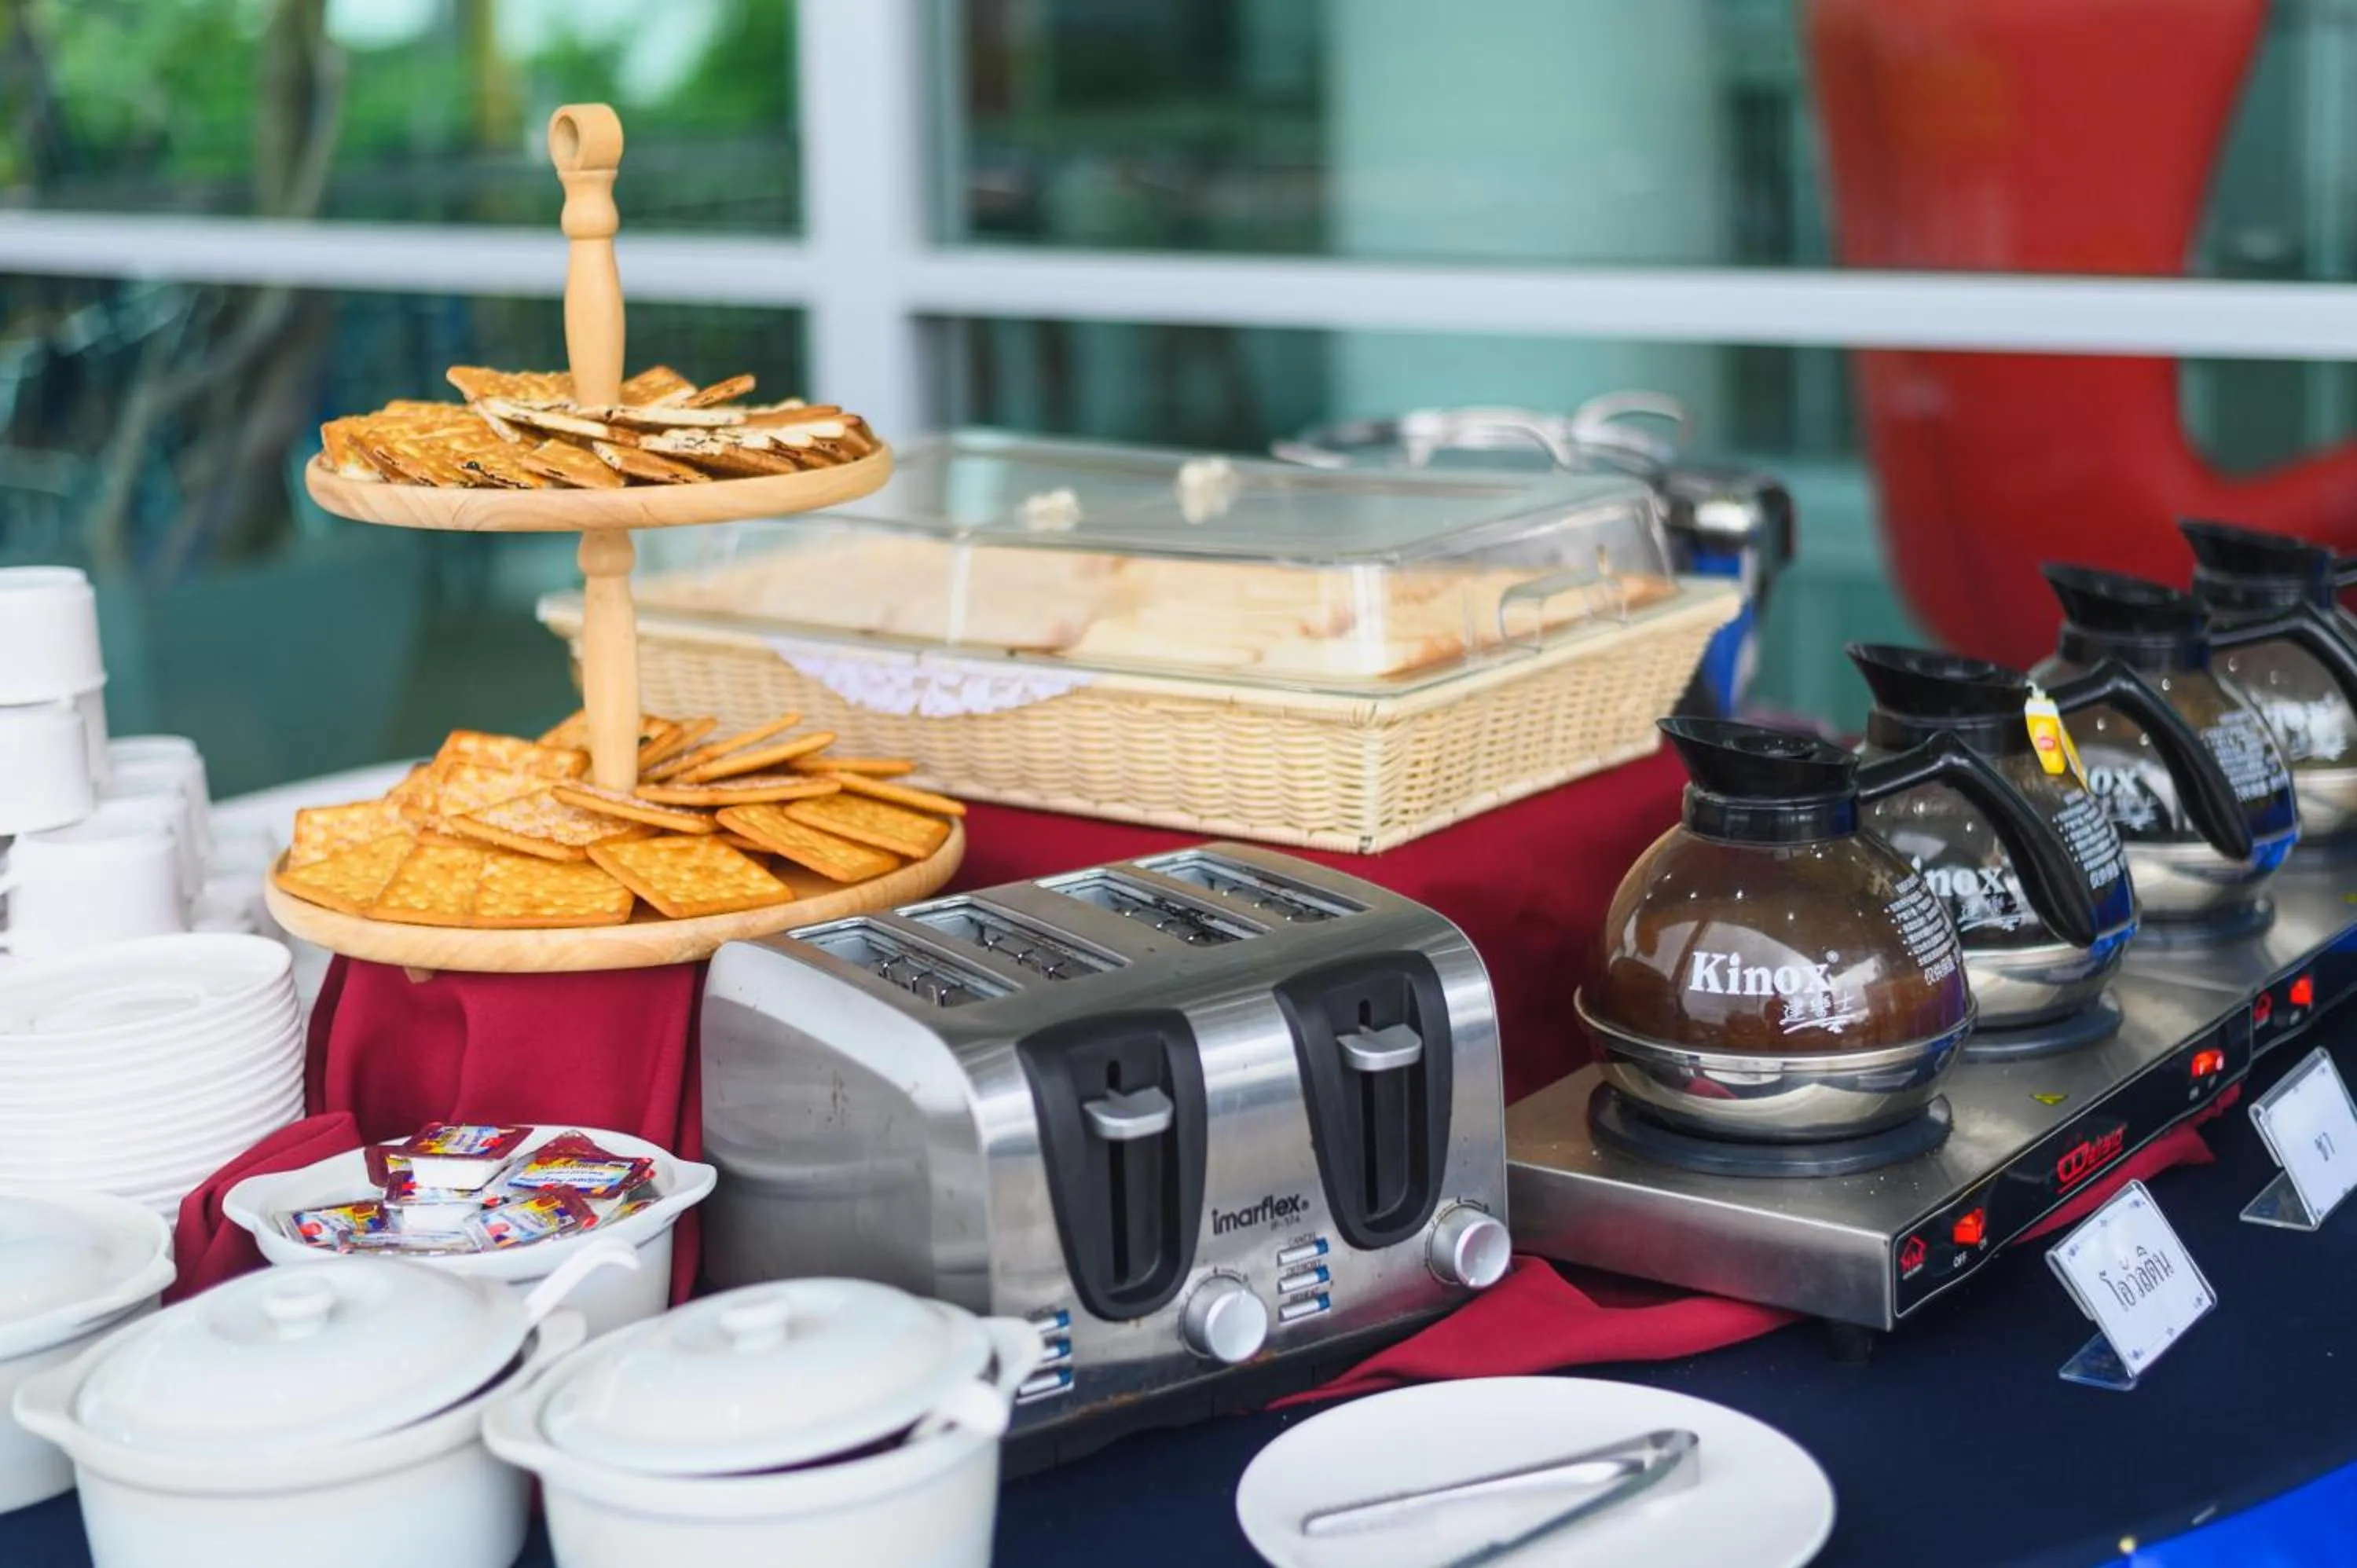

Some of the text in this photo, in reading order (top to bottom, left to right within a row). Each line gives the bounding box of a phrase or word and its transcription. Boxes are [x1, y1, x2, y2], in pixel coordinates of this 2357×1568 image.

[1688, 951, 1833, 996] Kinox
[1211, 1192, 1302, 1236] imarflex
[2099, 1246, 2175, 1313] โอวัลติน
